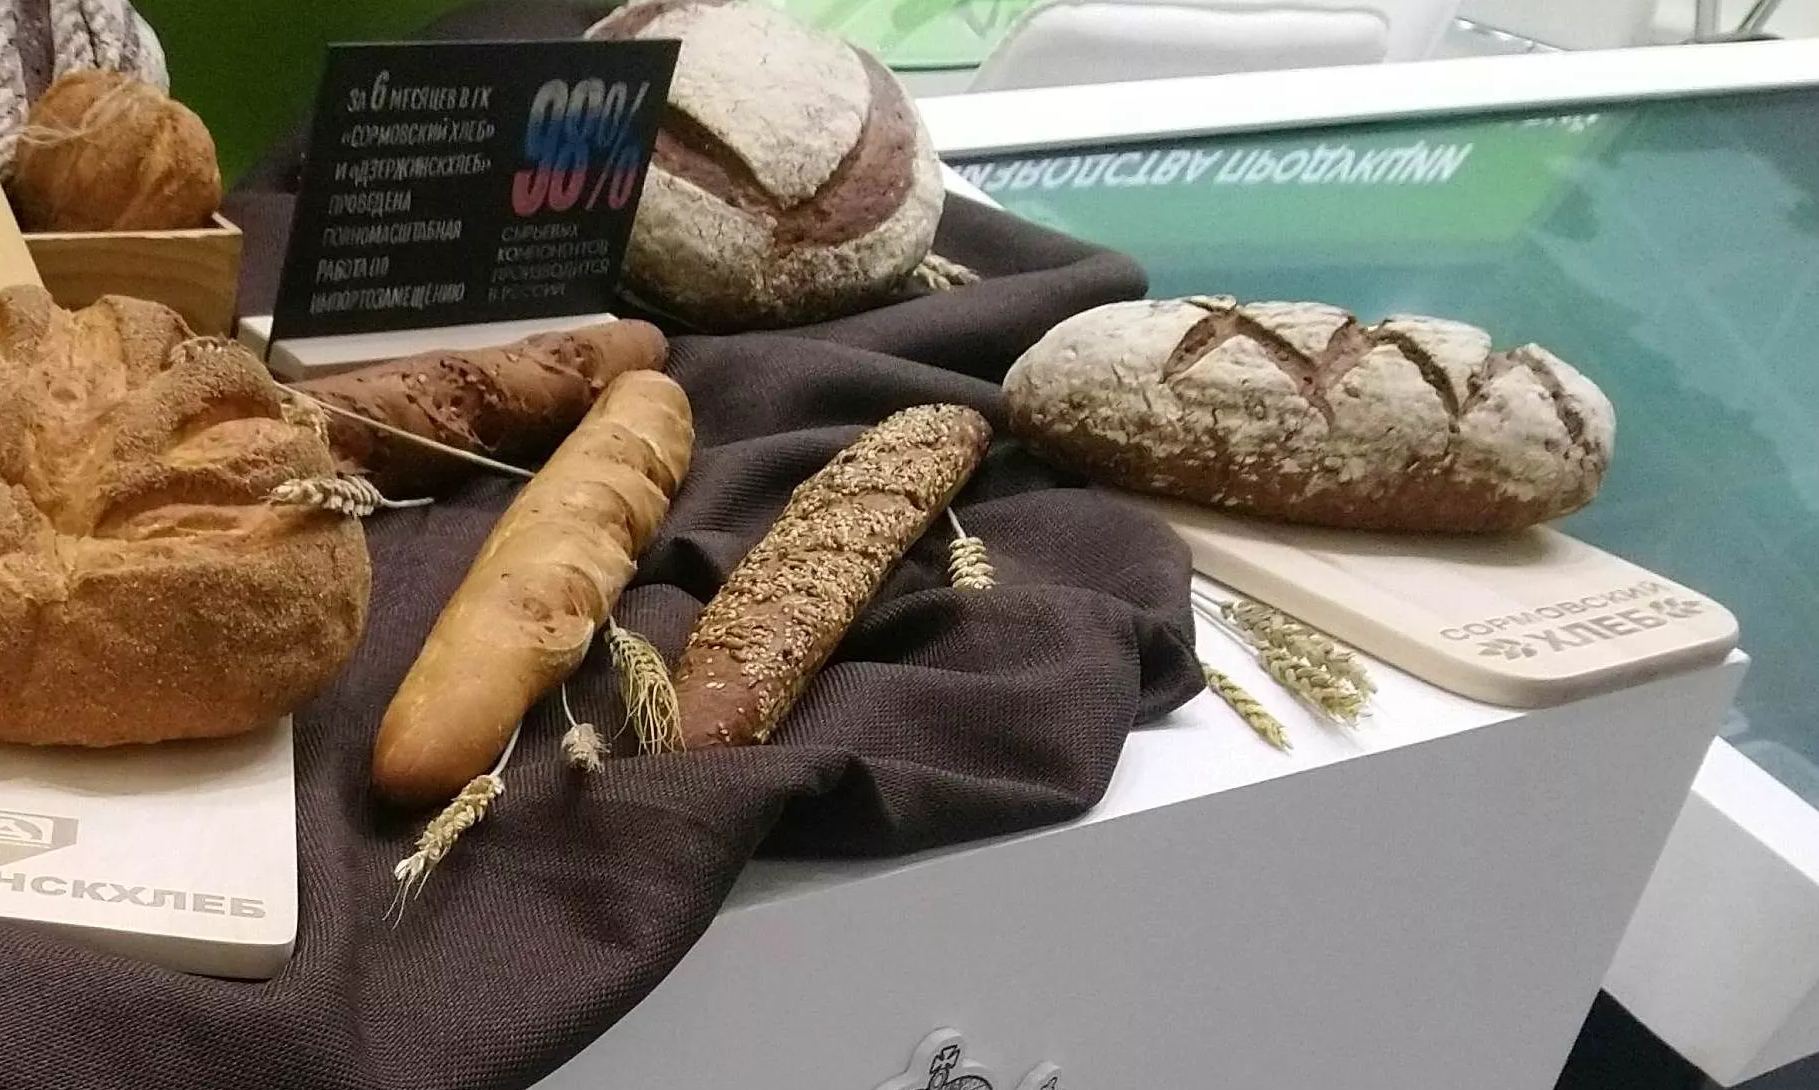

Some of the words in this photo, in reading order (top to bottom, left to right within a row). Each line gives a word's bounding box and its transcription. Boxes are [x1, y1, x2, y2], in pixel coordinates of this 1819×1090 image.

[346, 87, 366, 112] ЗА
[371, 70, 390, 111] 6
[390, 85, 458, 111] МЕСЯЦЕВ
[458, 86, 470, 109] В
[472, 85, 493, 110] ГК
[511, 77, 651, 216] 98%
[335, 161, 348, 181] И
[328, 190, 412, 217] ПРОВЕДЕНА
[322, 219, 462, 247] ПОЛНОМАСШТАБНАЯ
[316, 258, 367, 284] РАБОТА
[369, 256, 390, 277] ПО
[310, 282, 465, 315] ИМПОРТОЗАМЕЩЕНИЮ
[1439, 580, 1671, 642] СОРМОВСКИЙ
[1523, 607, 1668, 652] ХЛЕБ
